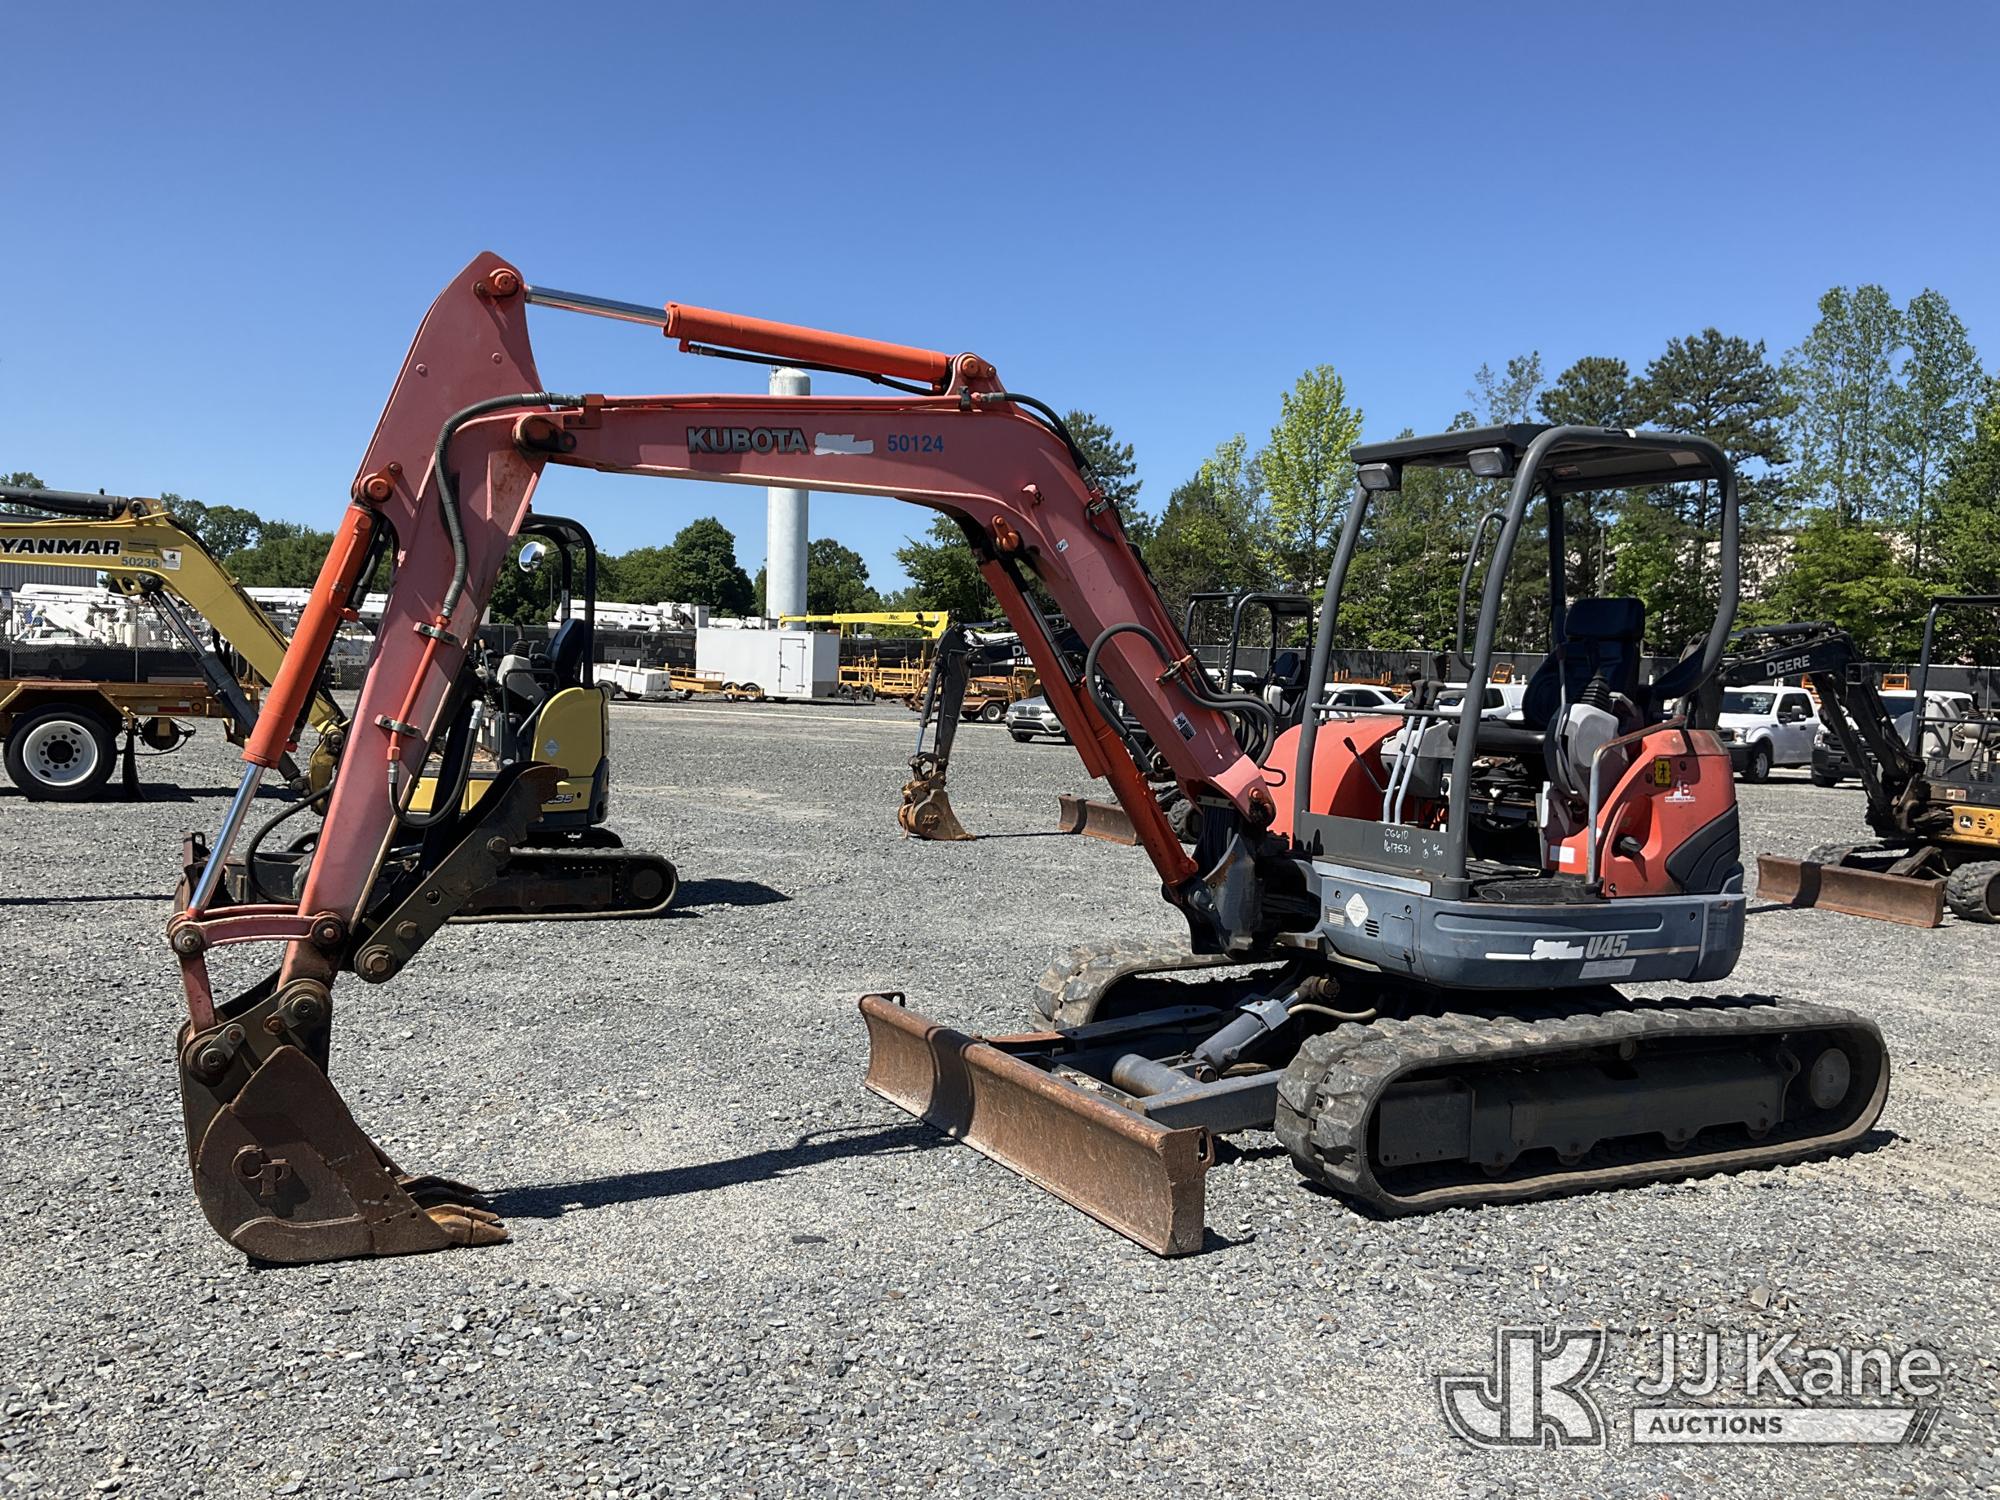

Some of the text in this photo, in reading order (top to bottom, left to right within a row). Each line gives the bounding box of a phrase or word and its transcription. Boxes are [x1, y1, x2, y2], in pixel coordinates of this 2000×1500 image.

[686, 427, 811, 455] KUBOTA
[886, 434, 945, 453] 50124
[0, 538, 121, 557] YANMAR
[121, 556, 160, 569] 50236
[1765, 654, 1810, 677] DEERE
[1585, 934, 1630, 959] U45
